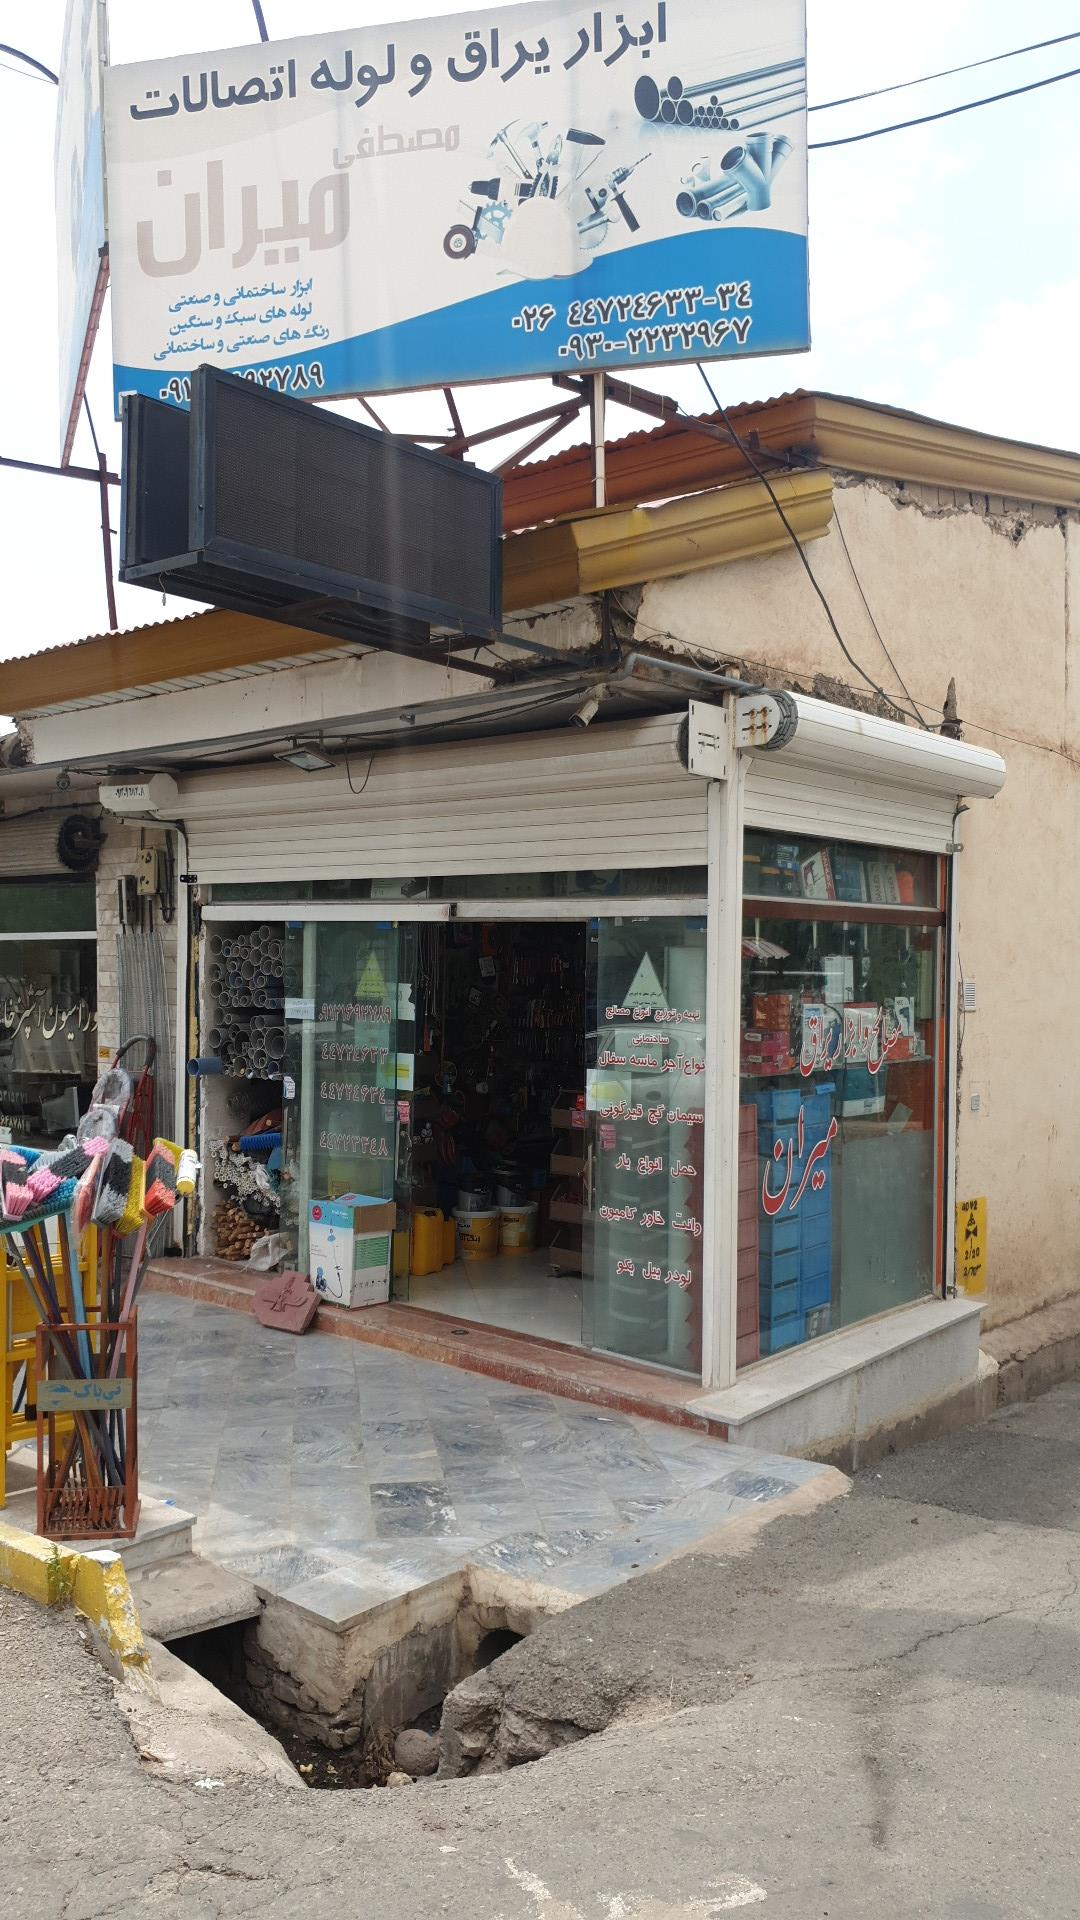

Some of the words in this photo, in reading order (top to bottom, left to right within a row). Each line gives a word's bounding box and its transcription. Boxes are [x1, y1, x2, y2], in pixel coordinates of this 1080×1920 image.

[564, 2, 666, 69] ابزار
[448, 28, 551, 82] یراق
[310, 44, 395, 107] لوله
[408, 54, 431, 97] و
[129, 59, 297, 120] اتصالات
[333, 124, 460, 169] مصطفی
[136, 159, 351, 278] میران
[223, 283, 286, 306] ساختمانی
[290, 278, 312, 297] ابزار
[168, 294, 212, 313] صنعتی
[213, 293, 221, 307] و
[225, 311, 257, 326] سبک
[259, 306, 287, 323] های
[289, 302, 313, 321] لوله
[511, 303, 556, 332] ۰۲۶
[169, 315, 213, 336] سنگین
[214, 316, 222, 329] و
[303, 324, 330, 340] رنگ
[227, 334, 271, 353] صنعتی
[273, 327, 301, 345] های
[153, 337, 215, 361] ساختمانی
[216, 339, 224, 353] و
[605, 1004, 631, 1020] مصالح
[632, 1005, 652, 1020] انواع
[654, 1007, 676, 1022] توزیع
[631, 1033, 669, 1046] ساختمانی
[800, 1014, 834, 1078] یراق
[598, 1050, 626, 1067] سفال
[629, 1055, 658, 1068] ماسه
[661, 1052, 684, 1072] آجر
[683, 1058, 706, 1076] نواع
[647, 1104, 666, 1124] گچ
[667, 1107, 704, 1125] سیمان
[637, 1155, 663, 1175] انواع
[670, 1160, 697, 1178] حمل
[762, 1105, 838, 1215] میران
[599, 1205, 637, 1221] کامیون
[640, 1210, 665, 1227] خاور
[671, 1212, 702, 1237] وانت
[642, 1262, 661, 1280] بیل
[664, 1270, 692, 1288] لودر
